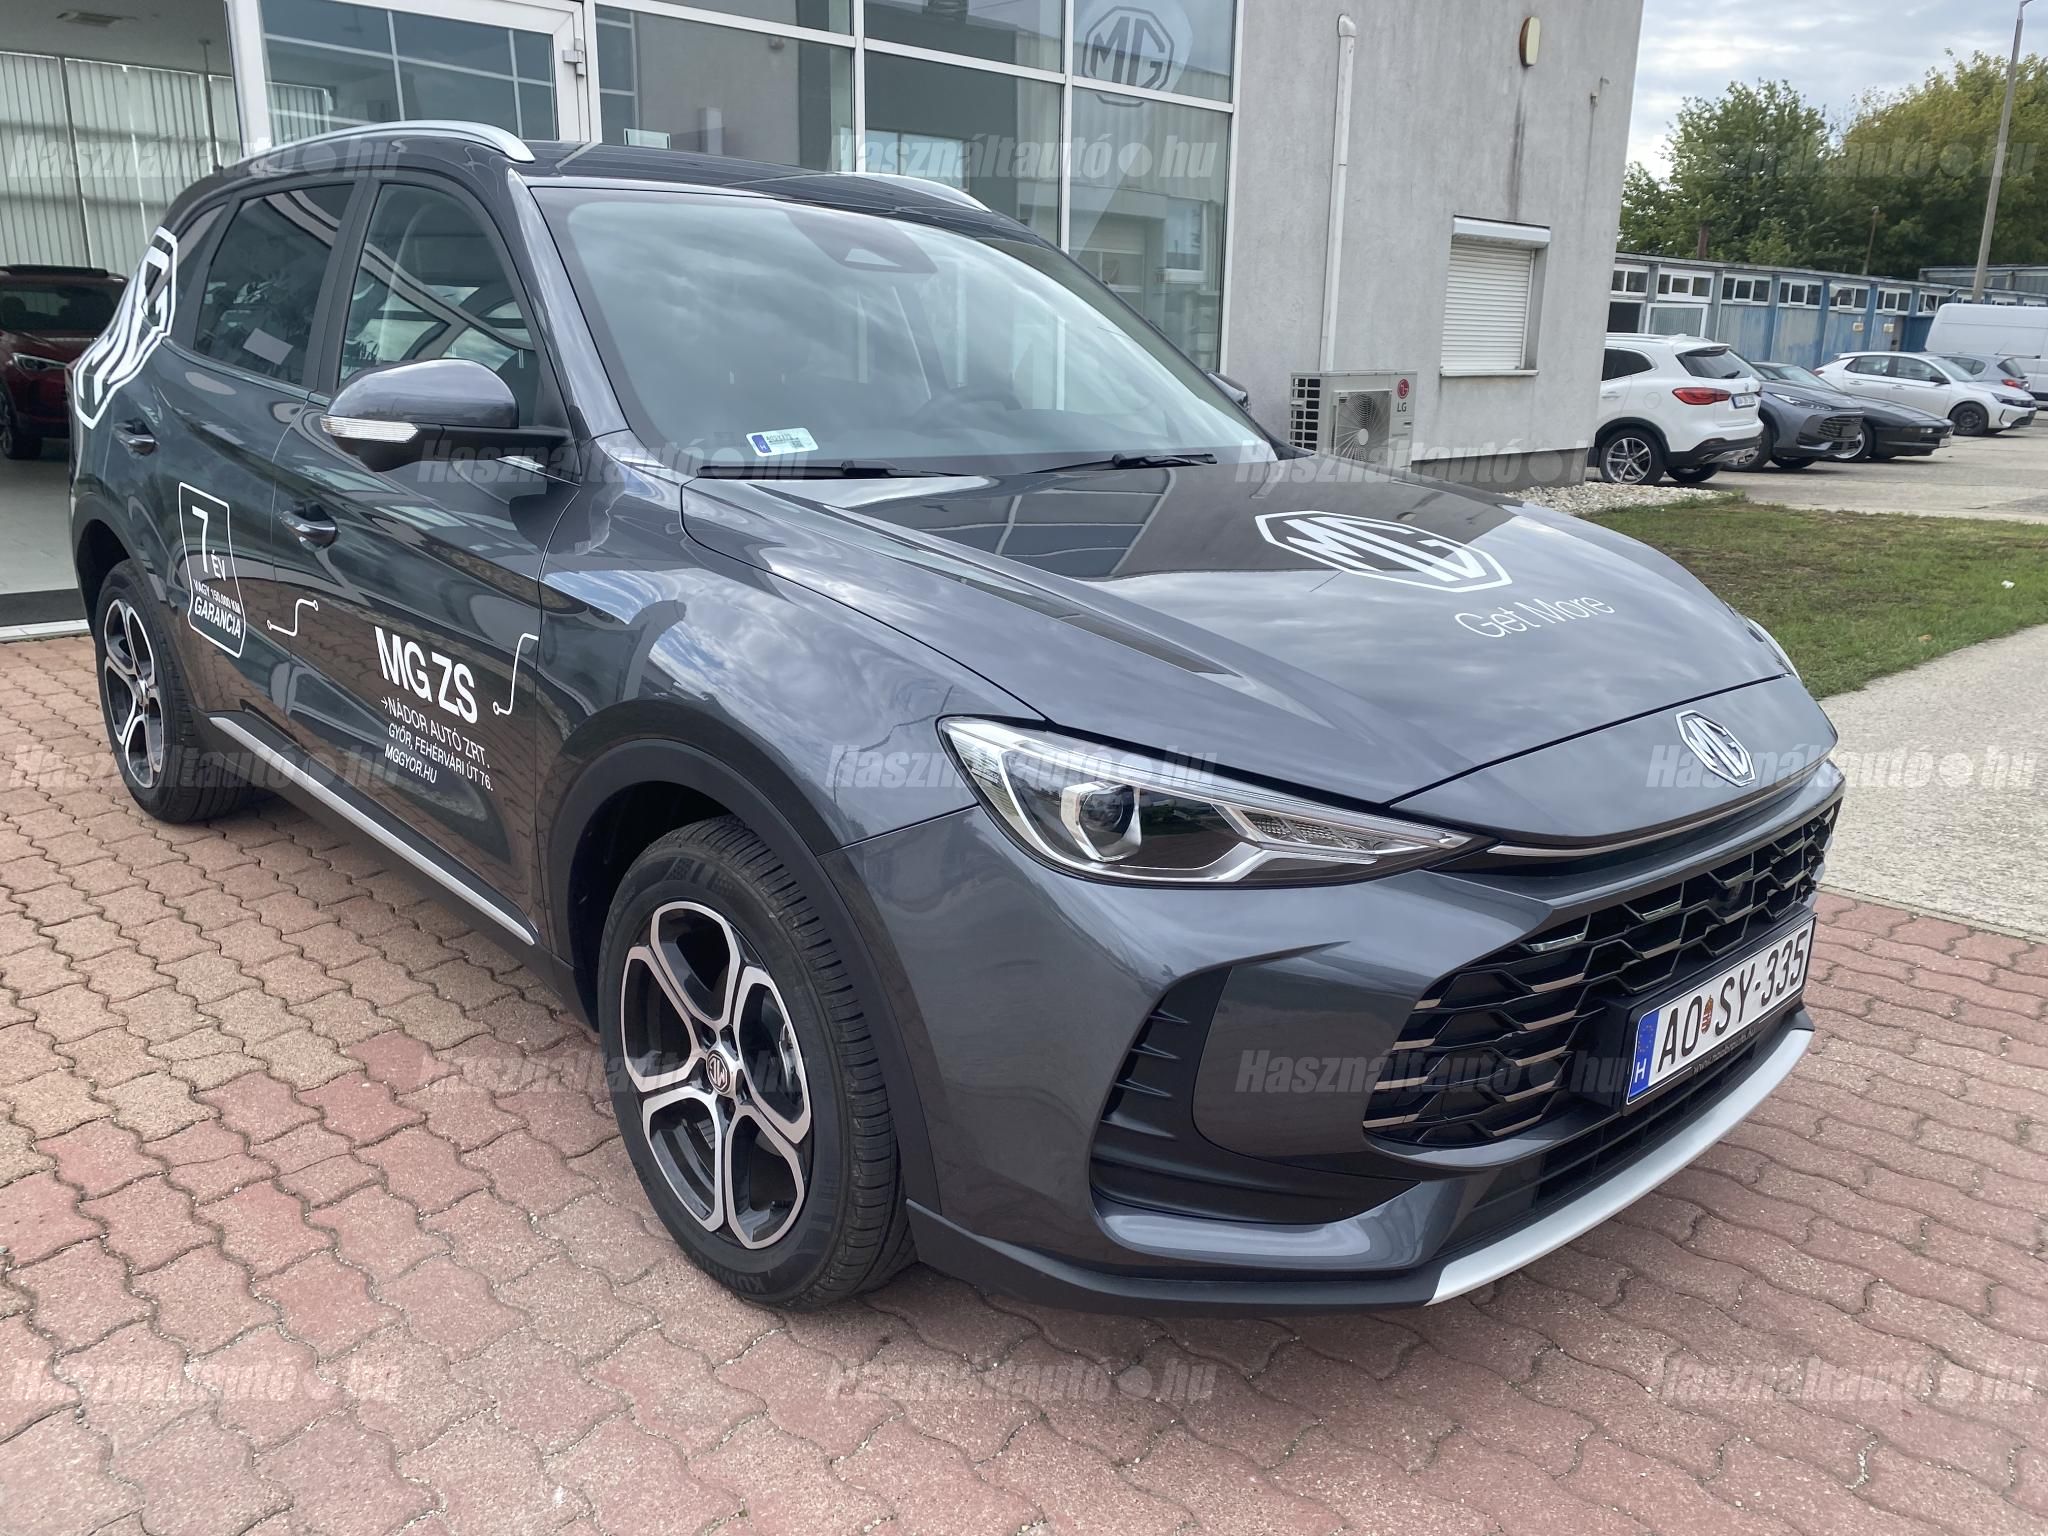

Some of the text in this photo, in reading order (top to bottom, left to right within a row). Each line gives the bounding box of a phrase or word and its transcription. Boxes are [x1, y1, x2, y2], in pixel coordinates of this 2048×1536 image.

[1088, 15, 1166, 89] MG
[1396, 402, 1407, 412] LG
[191, 505, 227, 582] 7 ÉV
[194, 596, 241, 639] GARANCIA
[1454, 594, 1615, 638] Get More
[375, 625, 478, 724] MG ZS
[385, 743, 438, 784] MGGYOR.HU
[387, 697, 491, 769] NÁDOR AUTÓ ZRT.
[388, 722, 494, 791] GYŐR, FEHÉRVÁRI ÚT 76.
[1684, 716, 1750, 780] MG
[1634, 928, 1809, 1083] H AO SY-335
